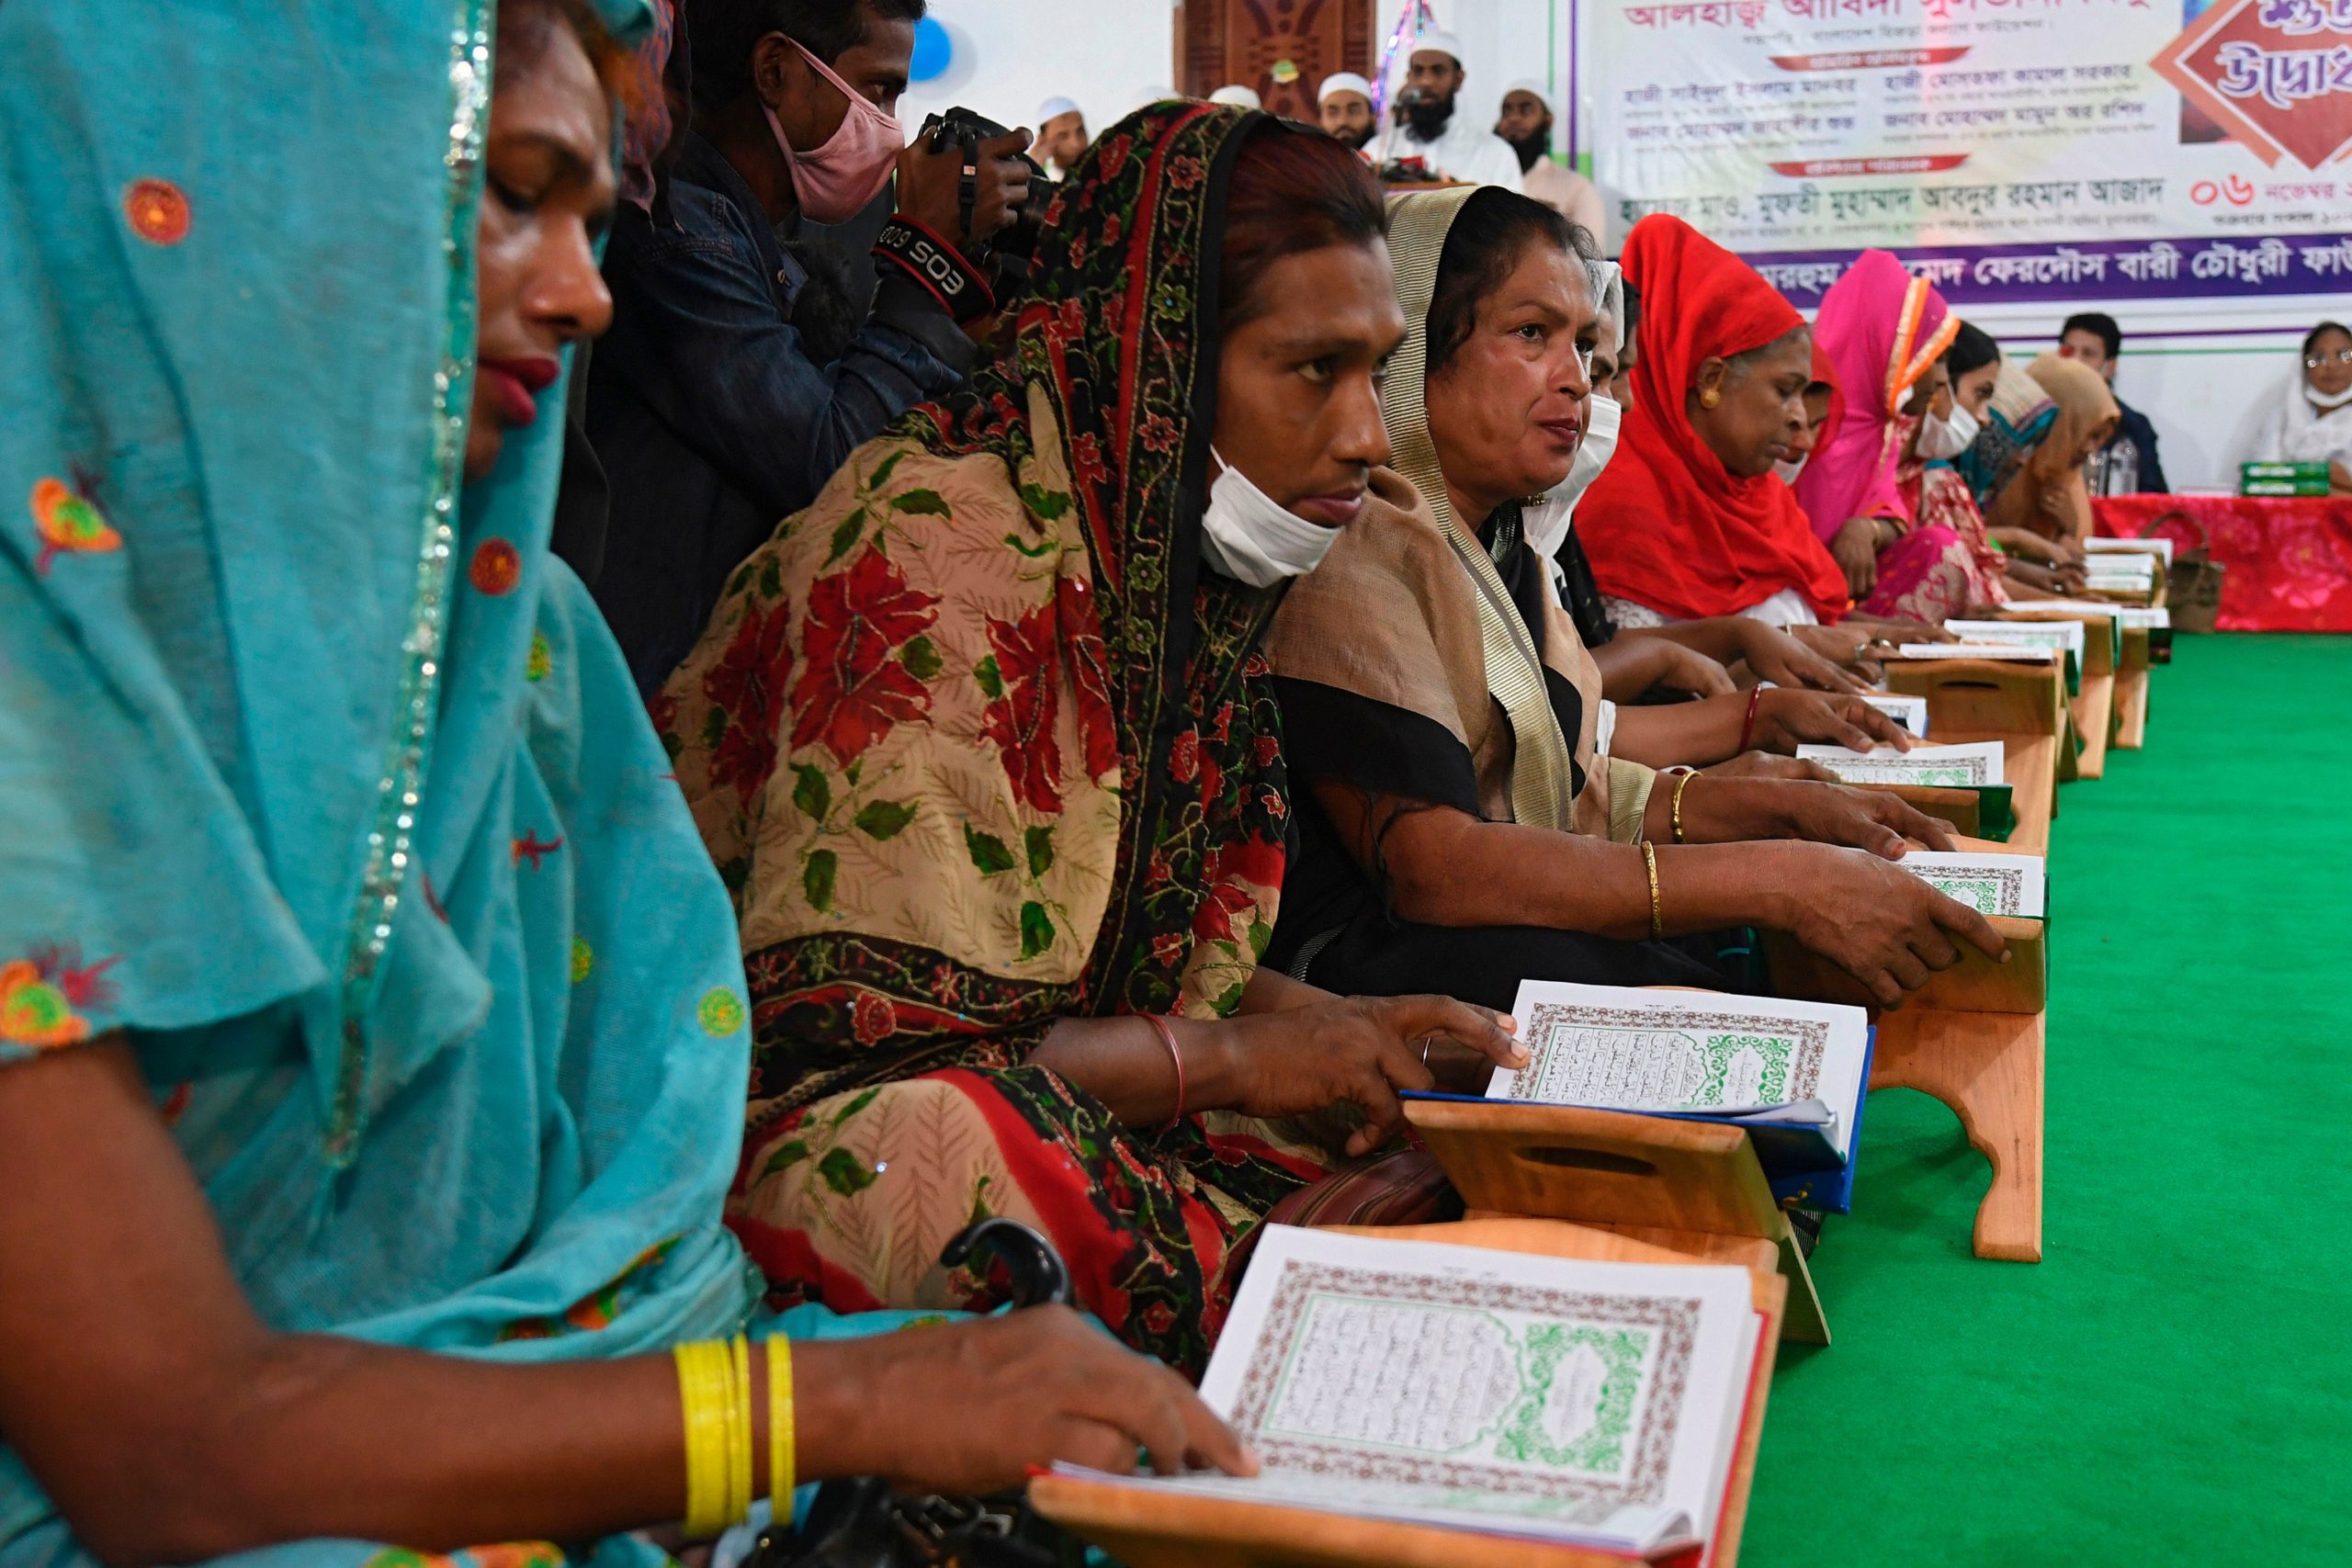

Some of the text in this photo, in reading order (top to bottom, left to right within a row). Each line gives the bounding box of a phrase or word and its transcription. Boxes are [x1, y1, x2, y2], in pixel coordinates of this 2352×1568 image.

[2006, 180, 2082, 211] রহমান
[2087, 176, 2166, 207] আজাদ
[2190, 173, 2256, 207] ০৬
[909, 240, 965, 296] EOS
[1973, 244, 2111, 285] ফেরদৌস
[2115, 241, 2183, 282] বারী
[2191, 237, 2293, 285] চৌধুরী
